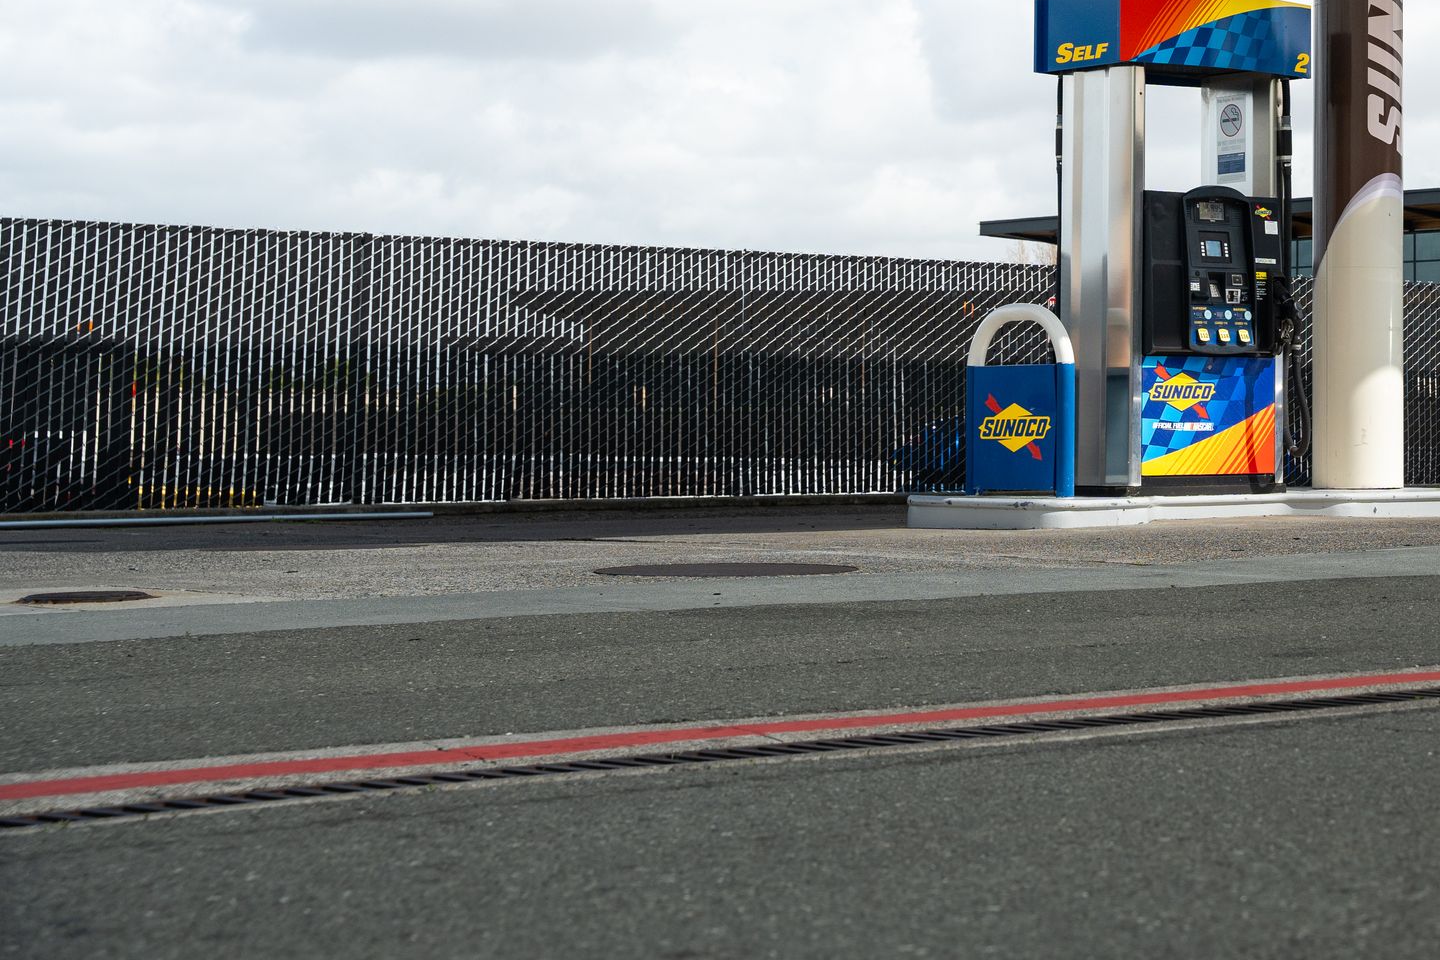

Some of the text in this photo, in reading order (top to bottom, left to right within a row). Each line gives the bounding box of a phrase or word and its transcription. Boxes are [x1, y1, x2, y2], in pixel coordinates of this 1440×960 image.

[1294, 53, 1310, 74] 2
[1151, 384, 1213, 400] SUNOCO
[981, 419, 1048, 438] SUNOCO
